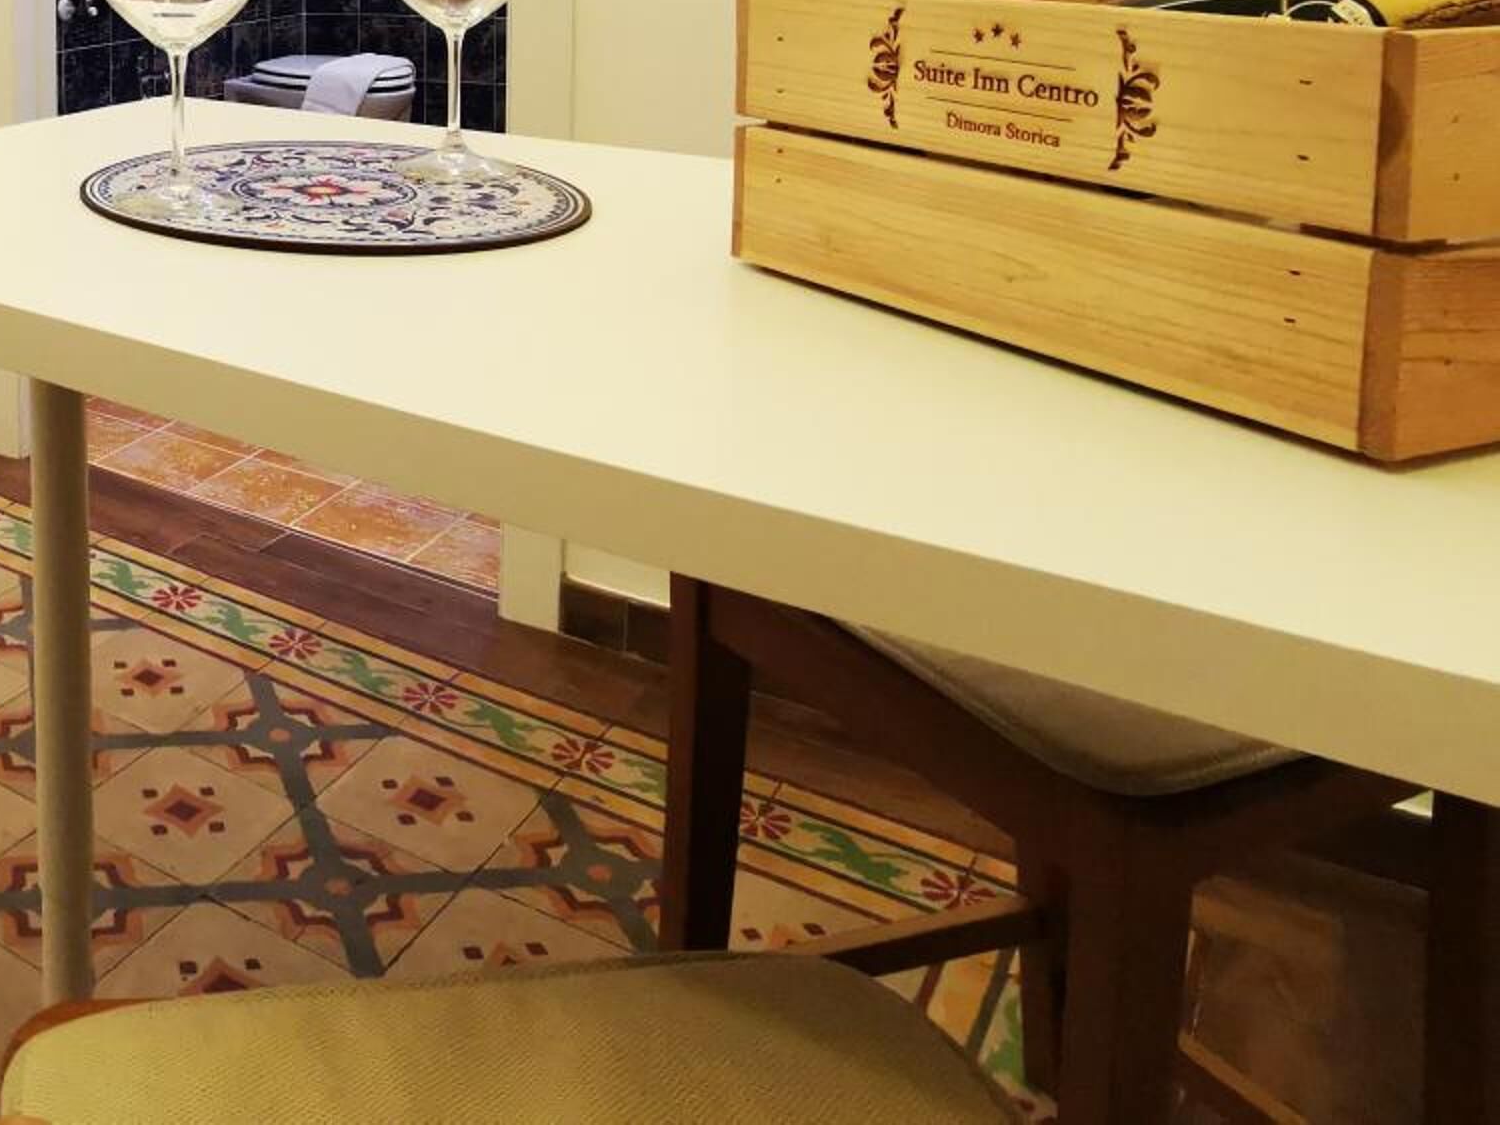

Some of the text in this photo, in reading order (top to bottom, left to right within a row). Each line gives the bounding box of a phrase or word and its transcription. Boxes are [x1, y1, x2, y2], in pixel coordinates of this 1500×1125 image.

[913, 60, 1099, 107] Suite Inn Centro
[946, 110, 1060, 148] Dimora Storica
